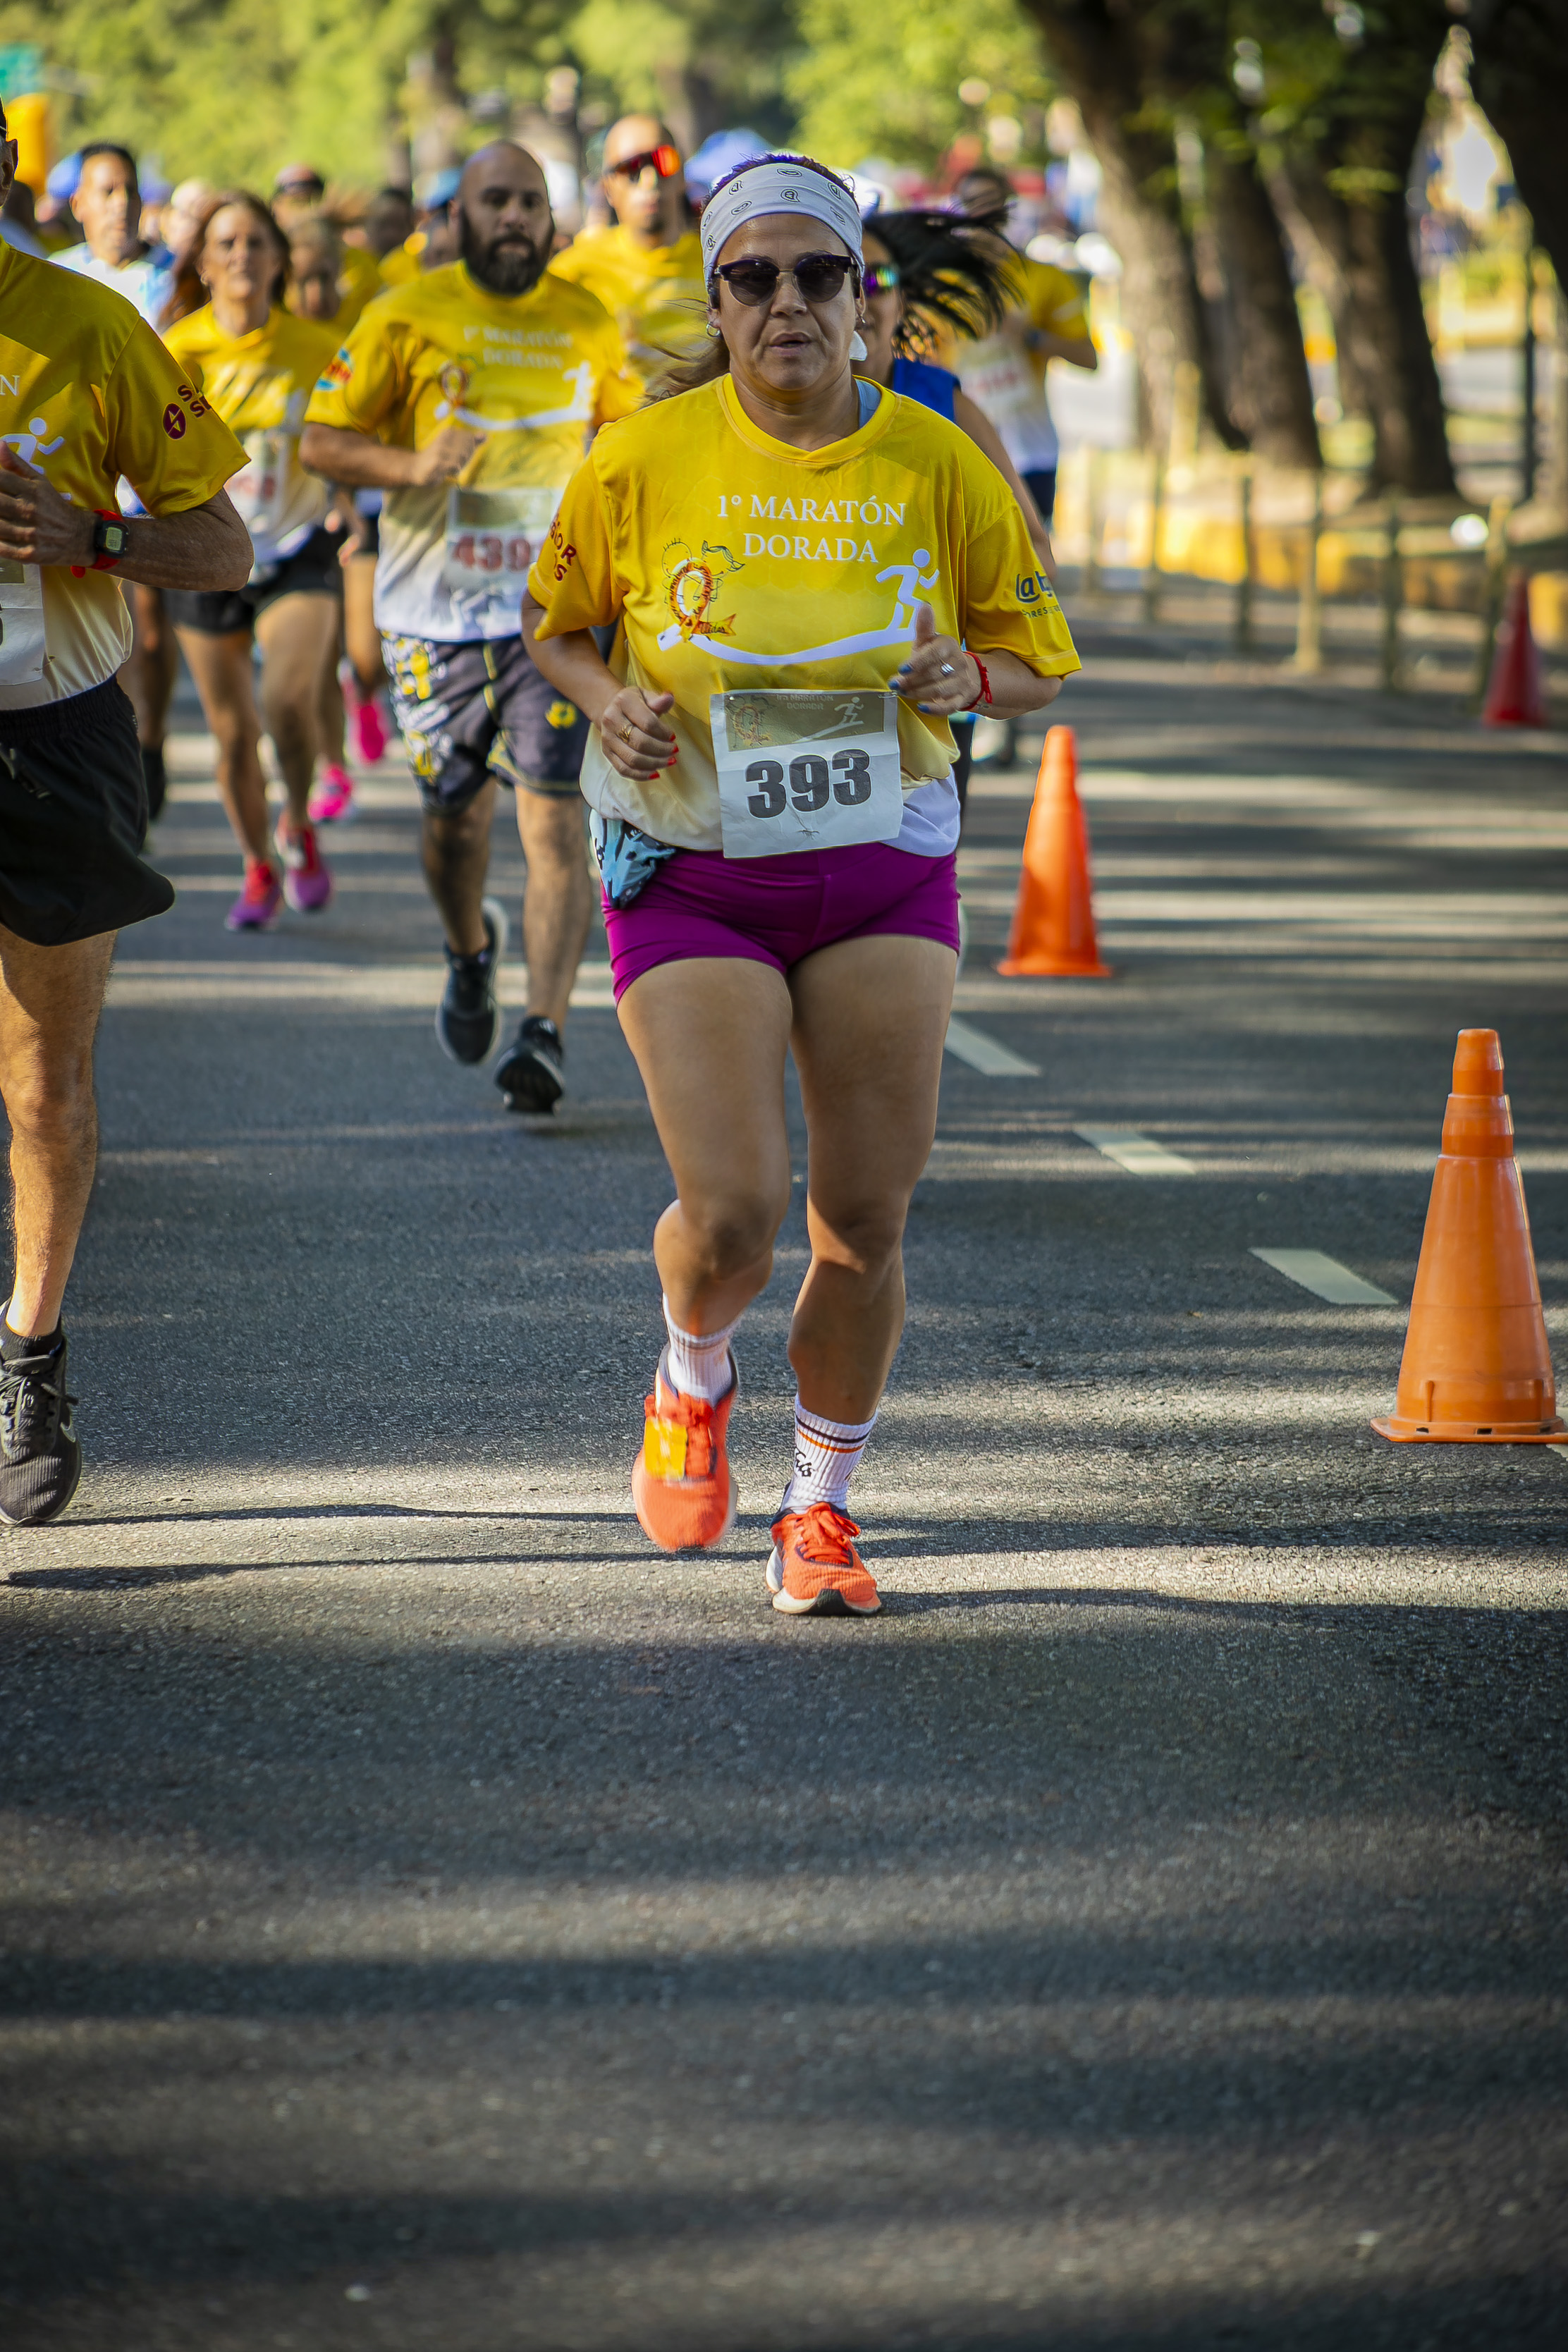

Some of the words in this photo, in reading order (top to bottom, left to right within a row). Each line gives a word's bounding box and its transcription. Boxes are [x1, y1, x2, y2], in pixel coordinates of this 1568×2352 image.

[749, 494, 907, 525] MARATÓN
[742, 533, 878, 563] DORADA
[745, 748, 872, 819] 393
